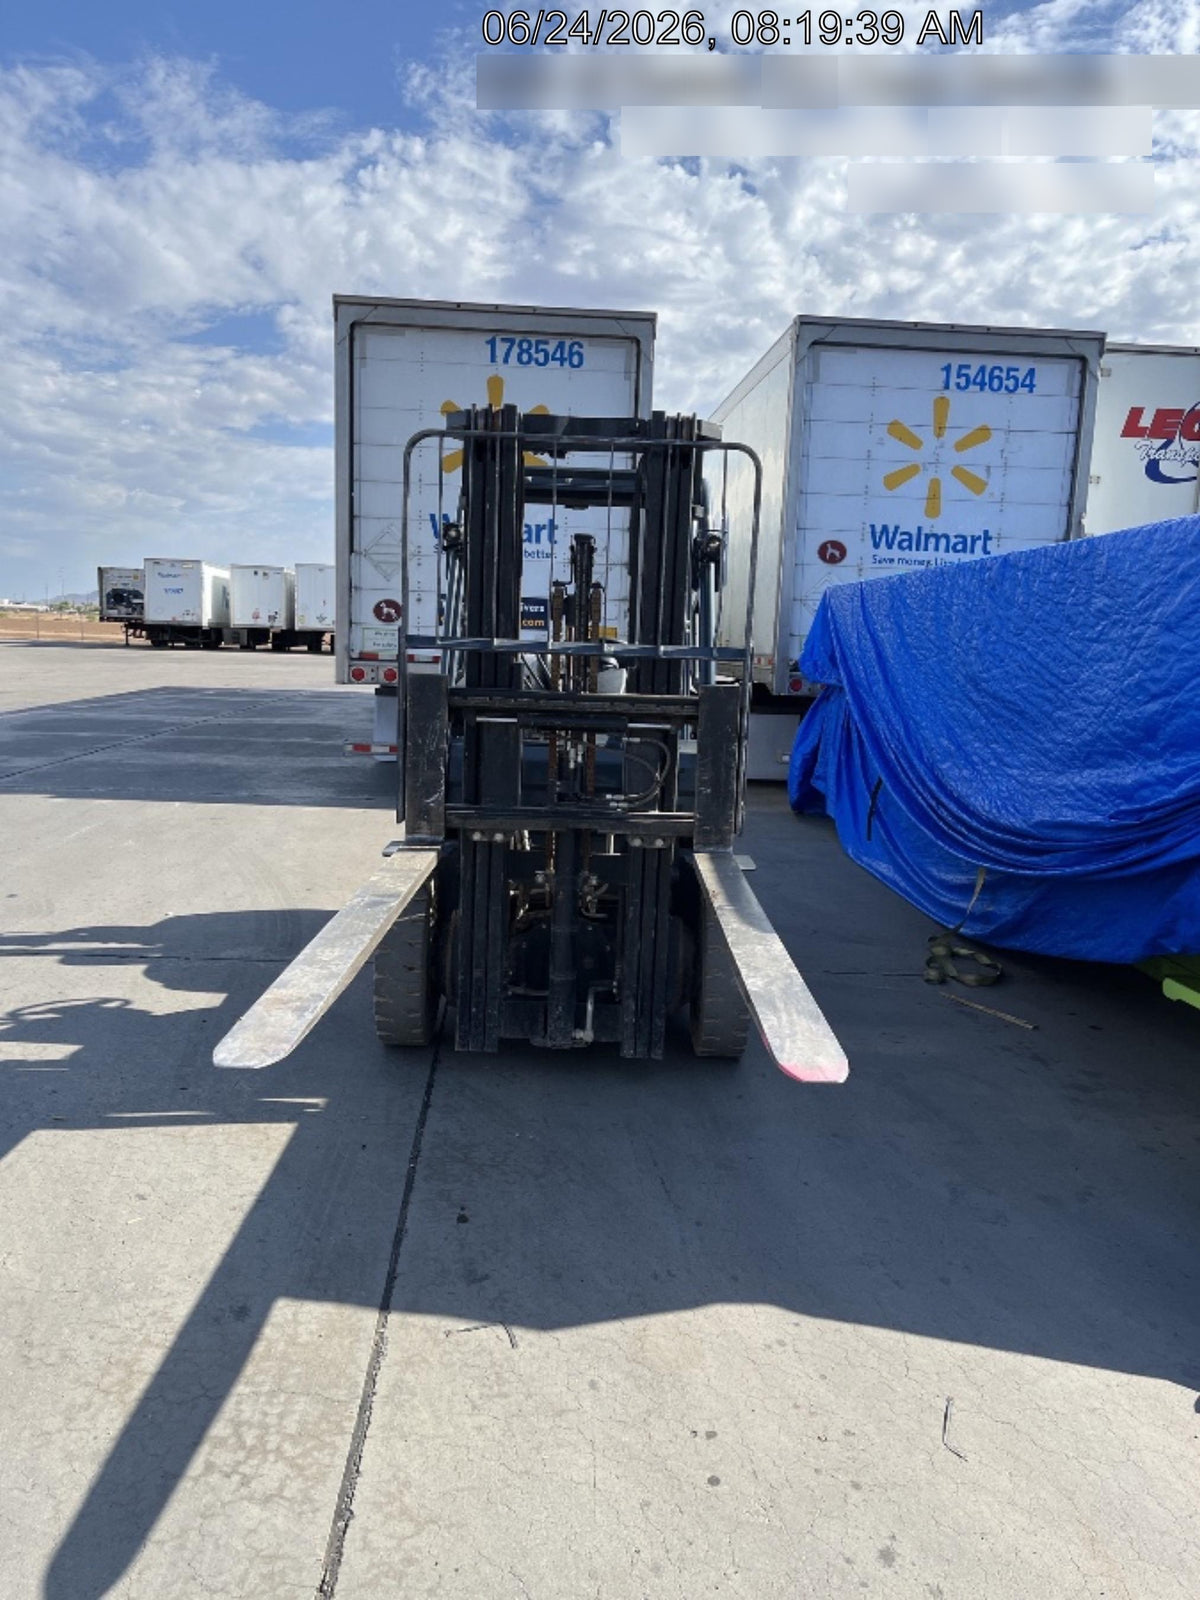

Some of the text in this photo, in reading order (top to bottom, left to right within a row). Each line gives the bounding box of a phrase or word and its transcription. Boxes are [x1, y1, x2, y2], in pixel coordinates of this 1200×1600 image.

[485, 335, 584, 369] 178546
[941, 362, 1037, 393] 154654
[869, 524, 993, 555] Walmart
[872, 554, 895, 565] Save
